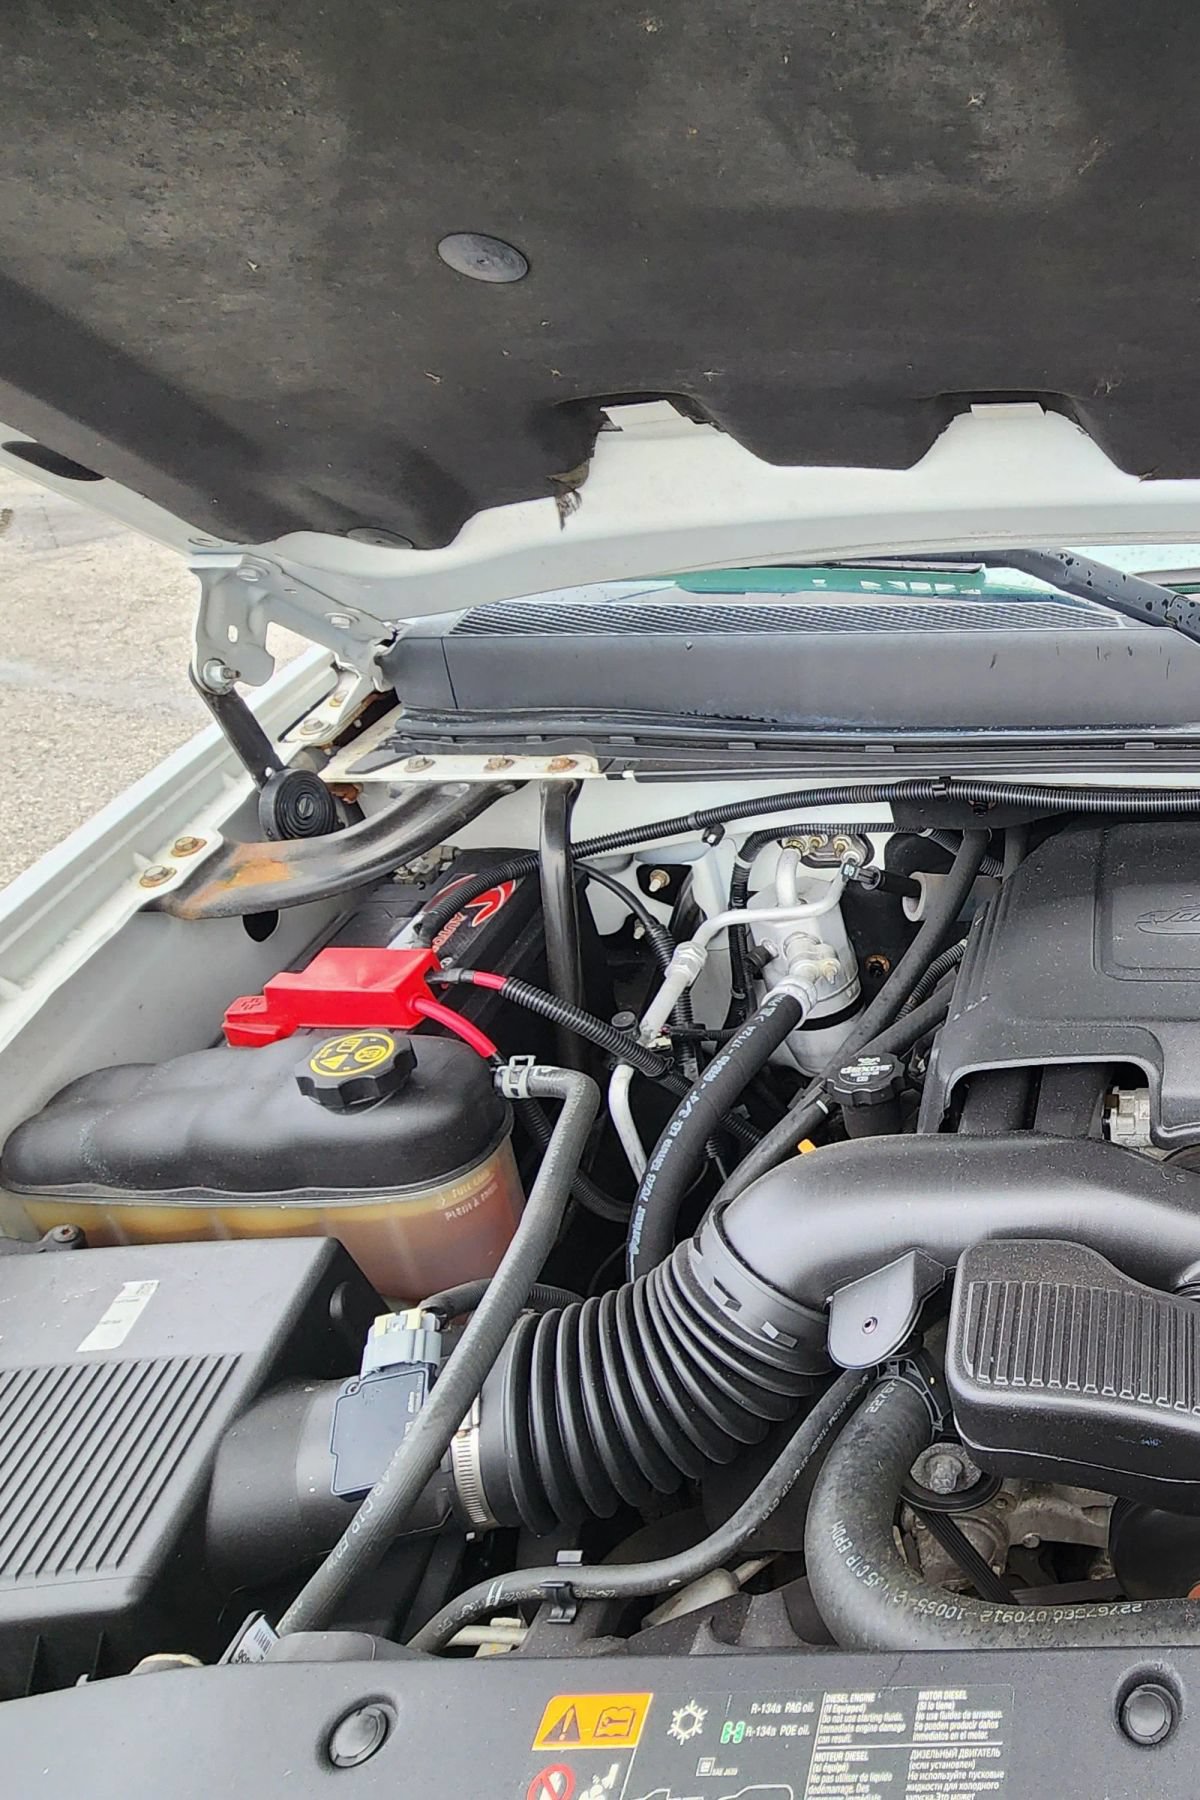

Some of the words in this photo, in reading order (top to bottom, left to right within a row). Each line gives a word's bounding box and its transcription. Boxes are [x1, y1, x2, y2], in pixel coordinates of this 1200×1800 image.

[826, 1693, 849, 1703] DIESEL
[850, 1692, 876, 1703] ENGINE
[918, 1690, 942, 1701] MOTOR
[943, 1689, 968, 1700] DIESEL
[750, 1702, 782, 1715] R-134a
[784, 1702, 802, 1714] PAG
[802, 1701, 815, 1713] oil.
[832, 1703, 867, 1714] Equipped)
[821, 1714, 831, 1723] Do
[831, 1714, 843, 1723] not
[915, 1711, 925, 1721] No
[962, 1710, 972, 1720] de
[745, 1725, 777, 1738] R-134a
[779, 1725, 798, 1737] POE
[797, 1724, 811, 1736] oil.
[855, 1723, 878, 1734] engine
[878, 1722, 906, 1734] damage
[914, 1721, 923, 1731] Se
[924, 1721, 949, 1732] pueden
[950, 1732, 959, 1741] en
[814, 1751, 844, 1762] MOTEUR
[844, 1750, 870, 1762] DIESEL
[910, 1747, 958, 1760] ДИЗЕЛЬНЫЙ
[958, 1747, 1001, 1760] ДВИГАТЕЛЬ
[859, 1772, 868, 1782] de
[919, 1770, 967, 1781] используйте
[968, 1770, 1005, 1781] пусковые
[958, 1781, 1000, 1792] холодного
